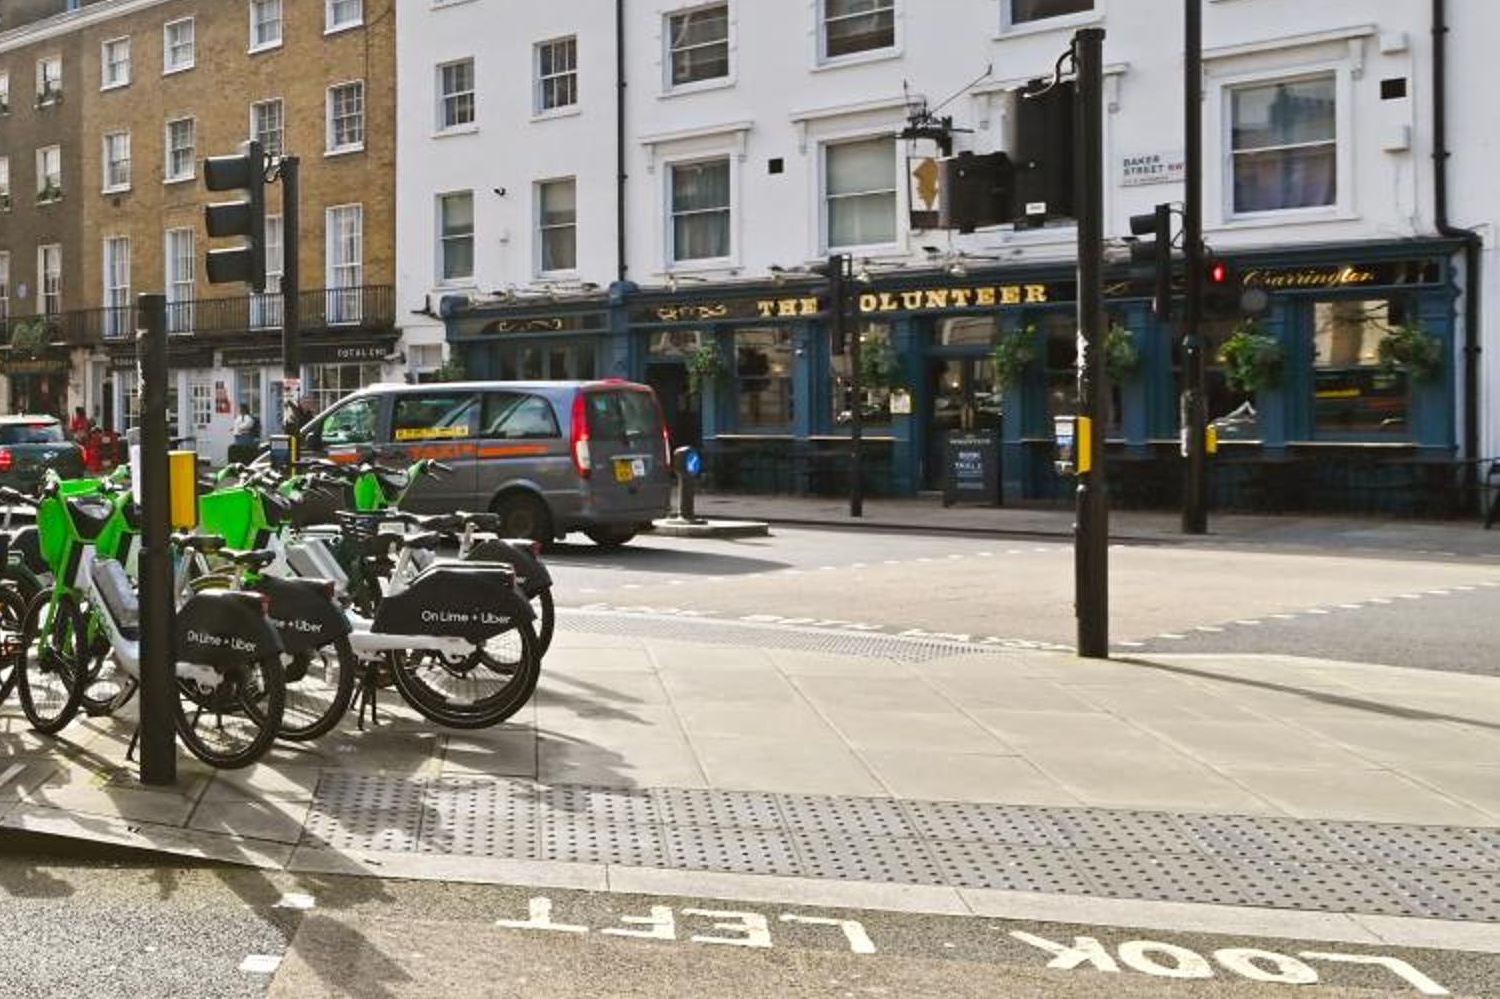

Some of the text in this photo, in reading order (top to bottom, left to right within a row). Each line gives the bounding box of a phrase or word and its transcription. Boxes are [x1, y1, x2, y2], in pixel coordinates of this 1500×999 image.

[1123, 155, 1160, 167] BAKER
[1123, 162, 1187, 176] STREET NW
[758, 284, 1048, 318] THE OLUNTEER
[421, 610, 438, 622] On
[440, 610, 469, 622] Lime
[481, 612, 512, 624] Uber
[295, 620, 322, 633] Uber
[199, 632, 222, 646] Lime
[231, 637, 257, 652] Uber
[494, 895, 1453, 997] LOOK LEFT
